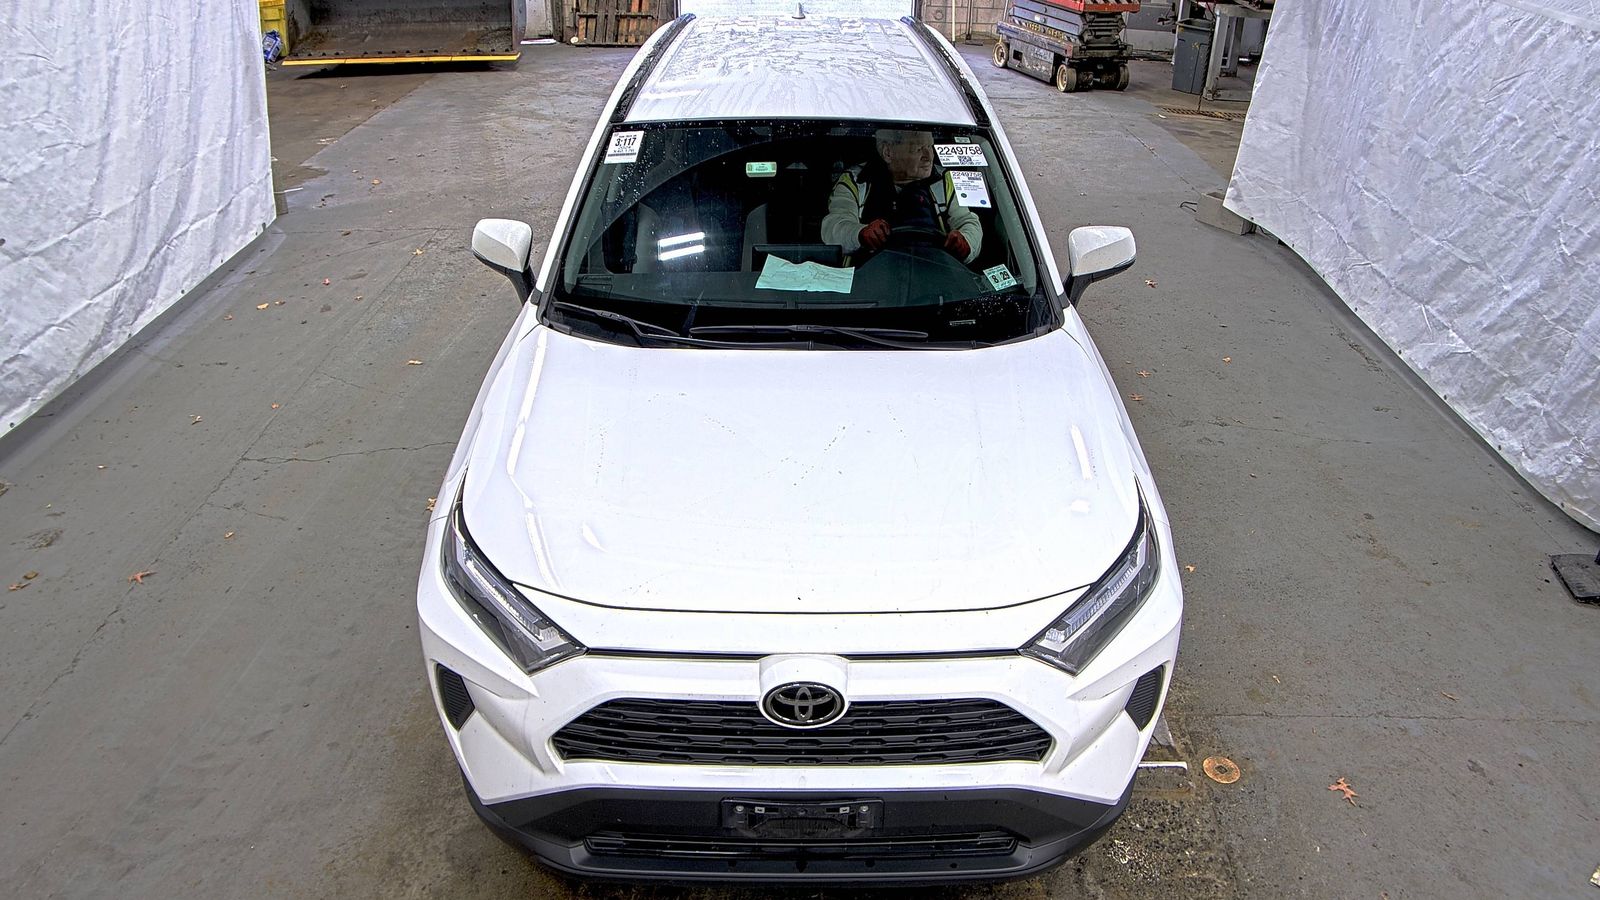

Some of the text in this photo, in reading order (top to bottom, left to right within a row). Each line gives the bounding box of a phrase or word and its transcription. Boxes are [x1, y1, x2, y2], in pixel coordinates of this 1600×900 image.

[615, 138, 637, 146] 3:117
[937, 146, 983, 155] 2249758
[992, 275, 999, 283] 8
